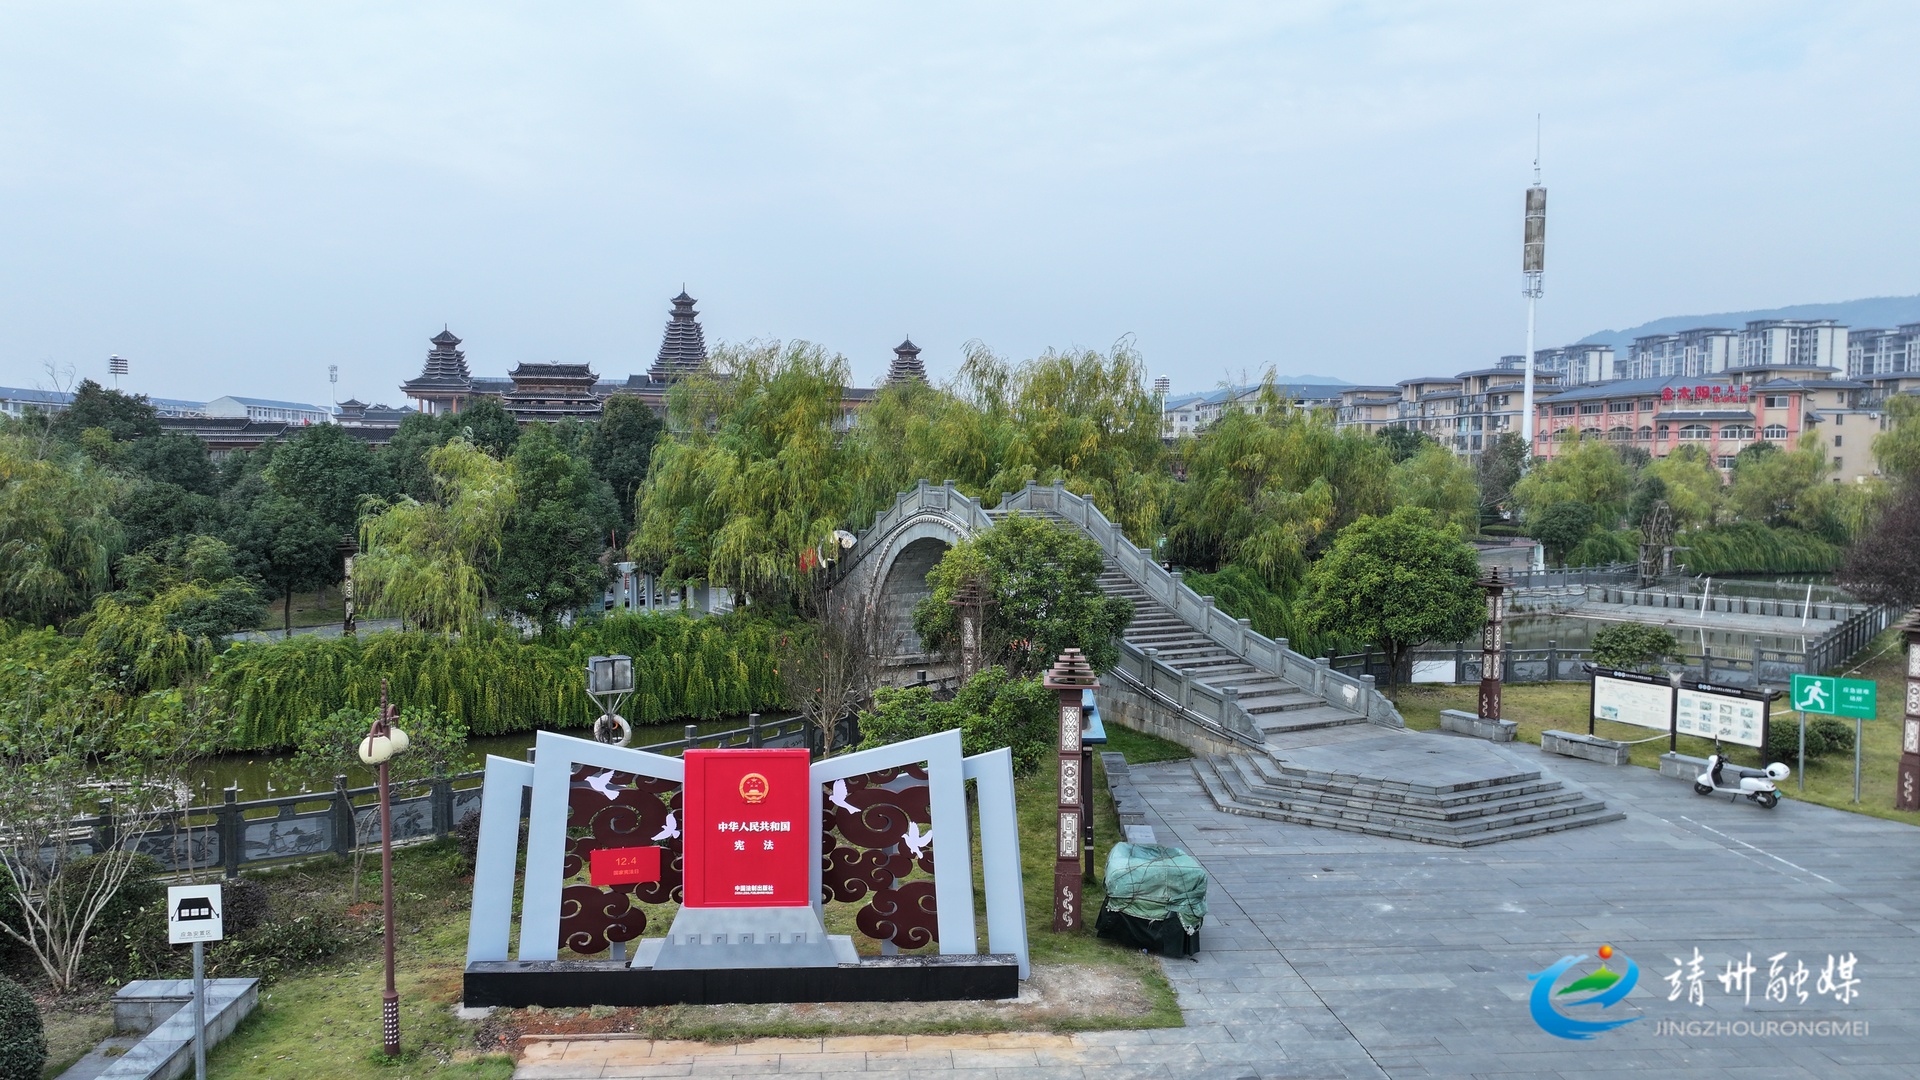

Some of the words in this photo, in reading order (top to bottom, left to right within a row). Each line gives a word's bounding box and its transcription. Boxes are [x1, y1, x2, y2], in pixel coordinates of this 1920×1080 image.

[1661, 386, 1710, 401] 金太阳
[718, 821, 791, 833] 中华人民共和国
[734, 839, 774, 851] 宪法
[615, 857, 637, 866] 12.4
[734, 884, 774, 892] 中国法制出版社
